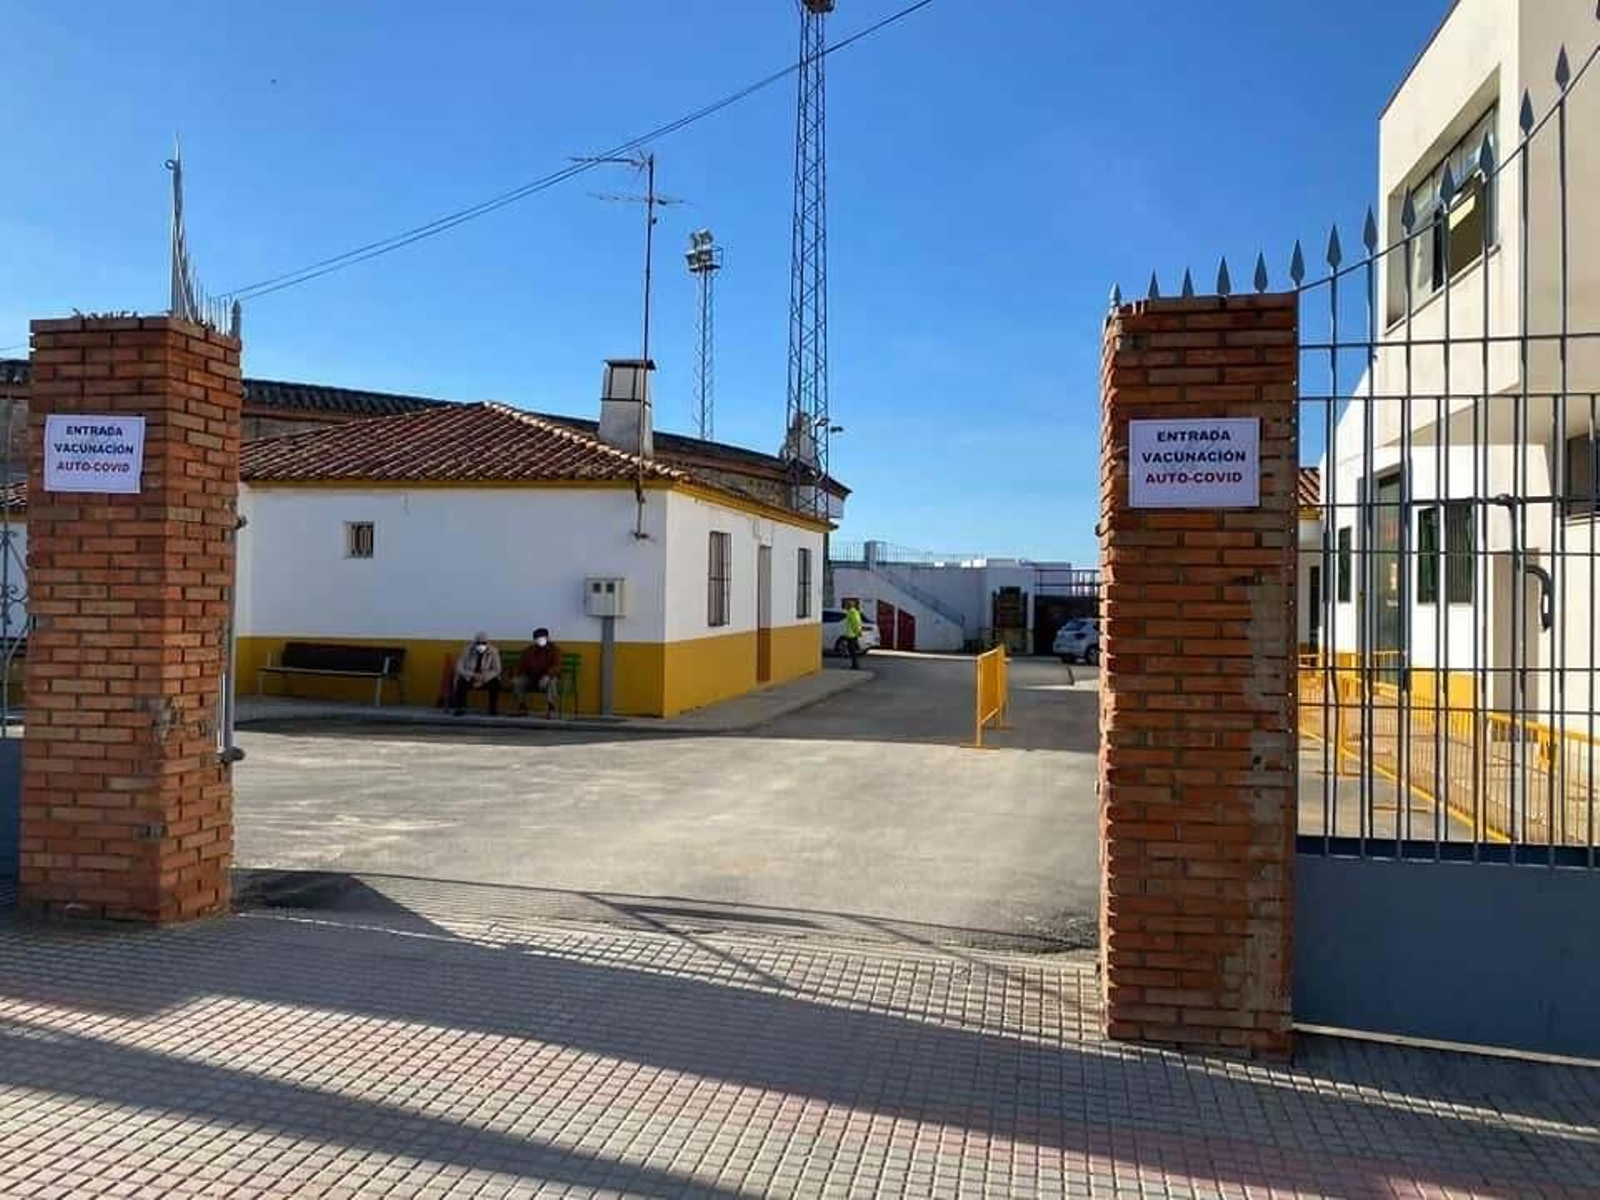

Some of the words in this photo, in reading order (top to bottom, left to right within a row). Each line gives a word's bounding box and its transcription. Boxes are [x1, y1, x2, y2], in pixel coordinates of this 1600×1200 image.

[66, 426, 123, 436] ENTRADA
[1156, 430, 1231, 442] ENTRADA
[56, 461, 130, 472] AUTO-COVID
[1145, 472, 1243, 484] AUTO-COVID
